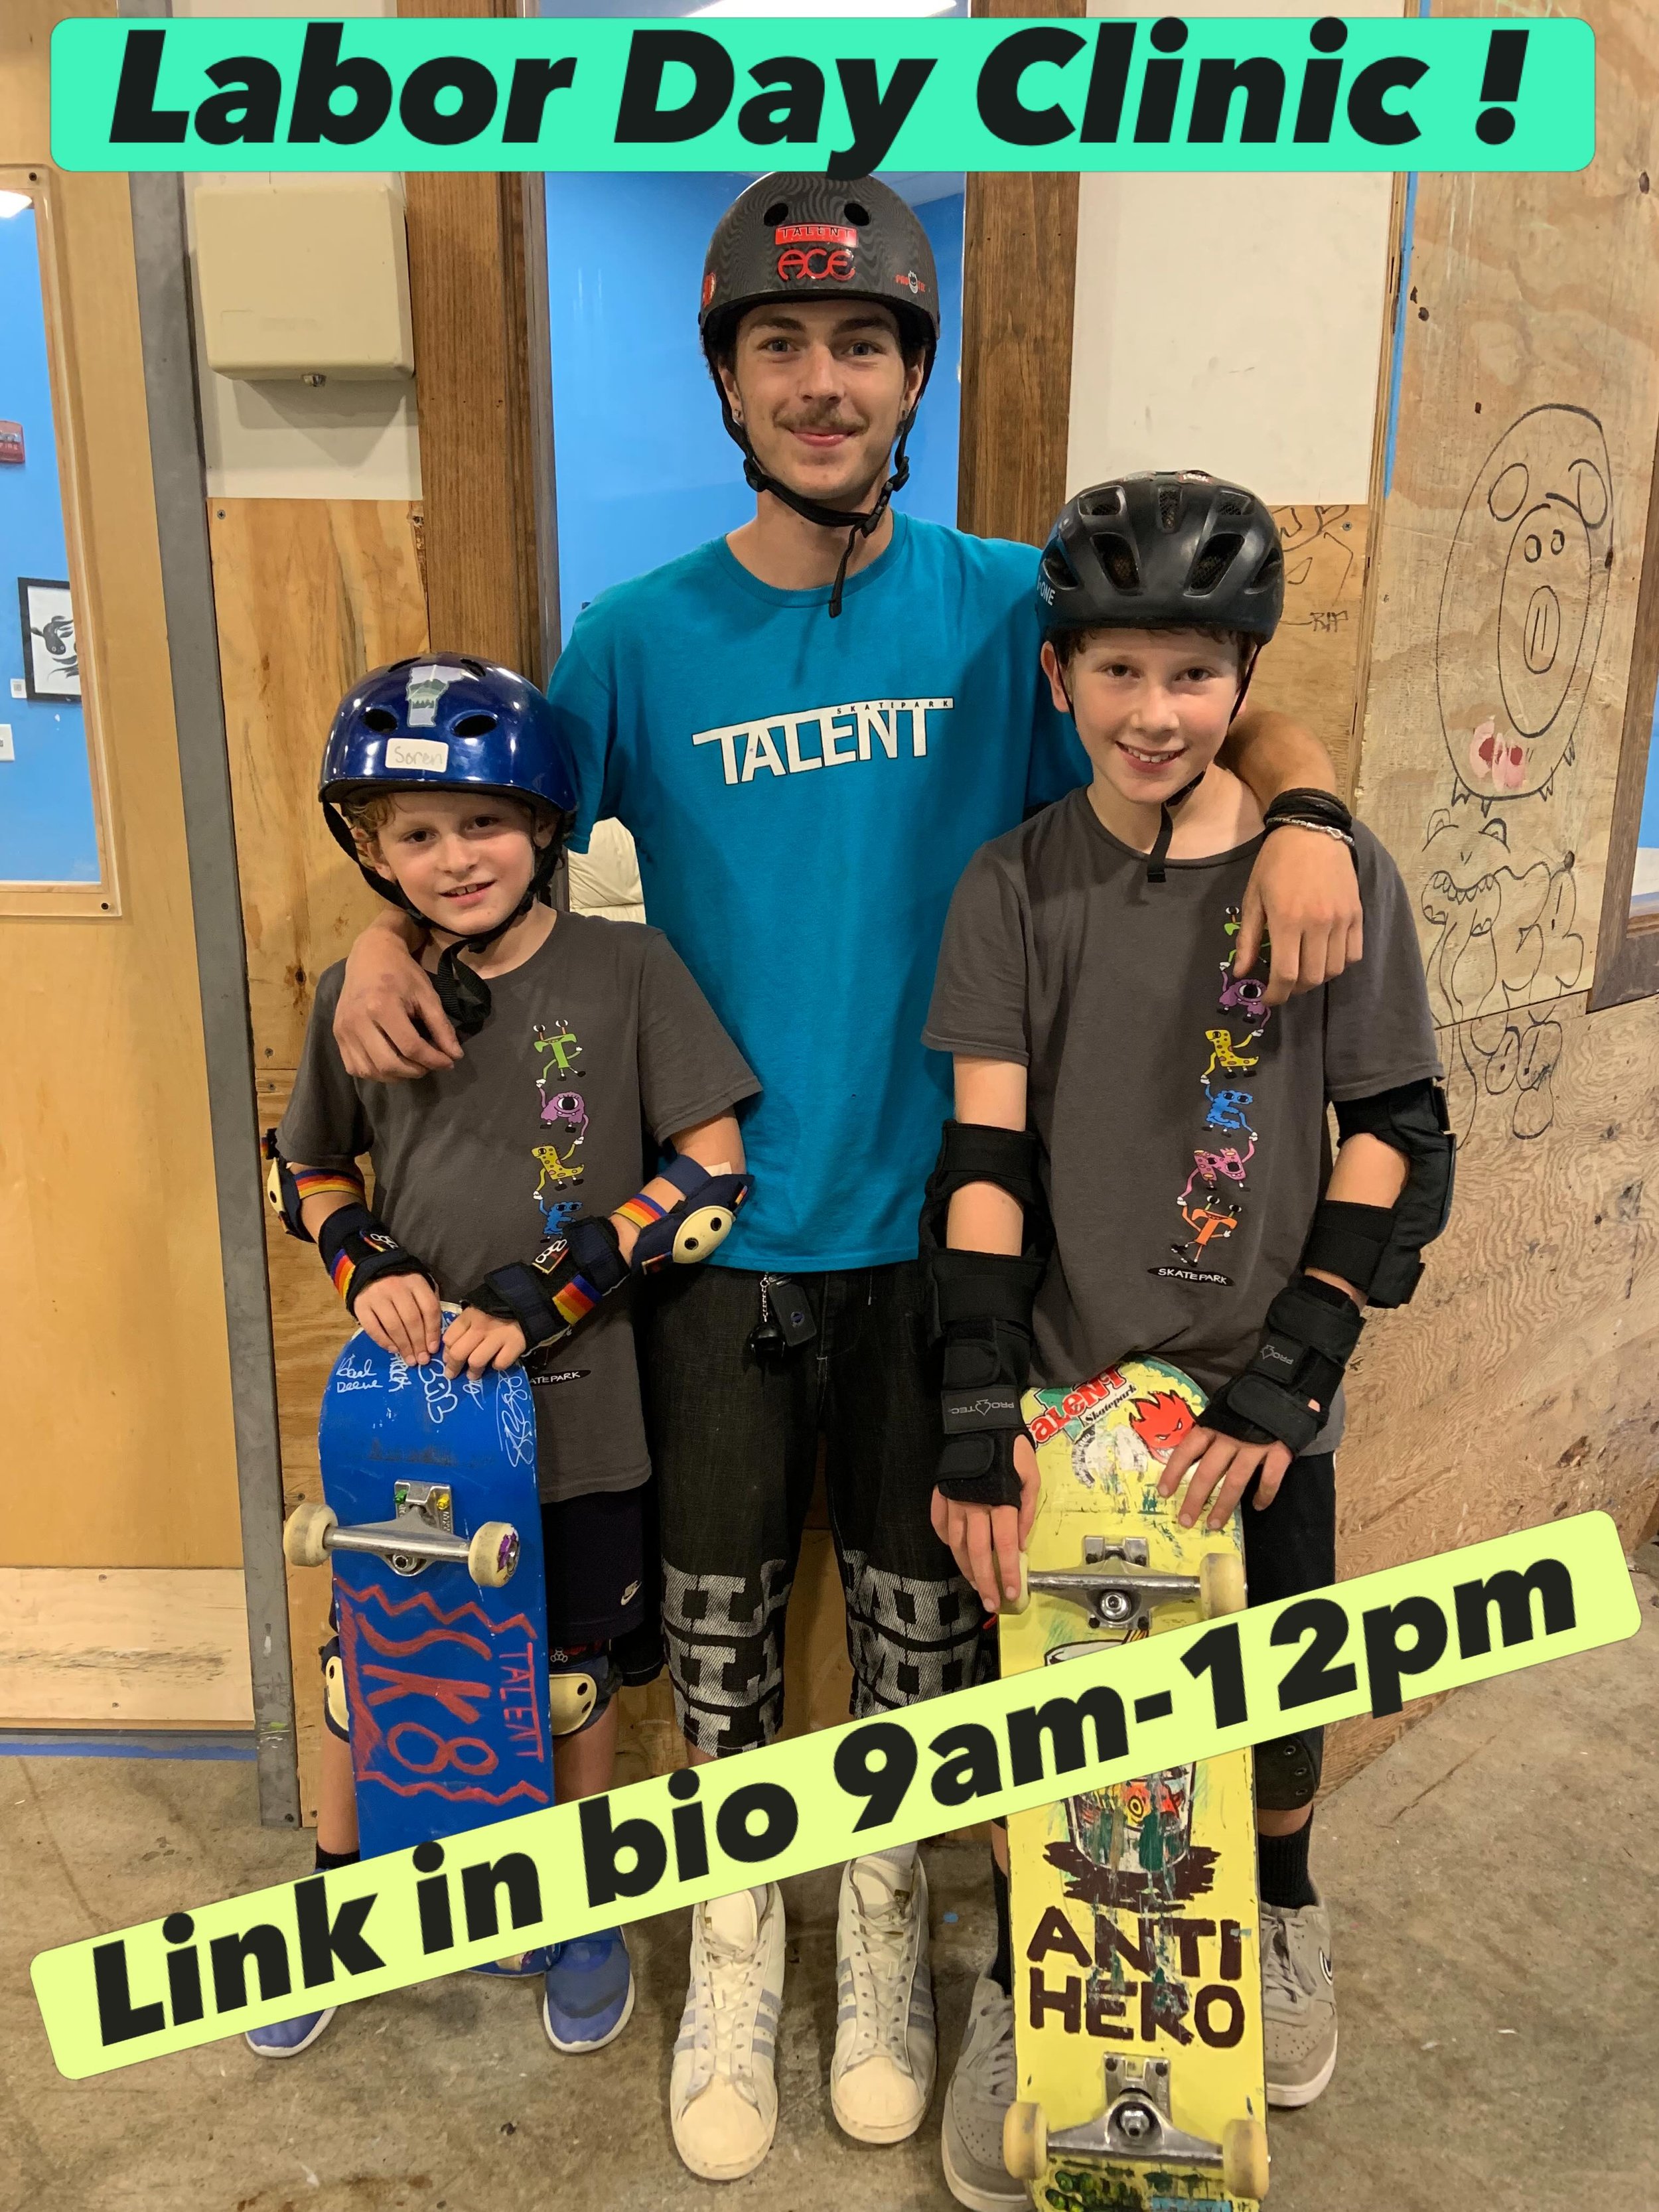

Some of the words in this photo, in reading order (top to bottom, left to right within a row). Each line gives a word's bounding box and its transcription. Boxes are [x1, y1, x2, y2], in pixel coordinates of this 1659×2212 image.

[778, 224, 855, 238] TALENT
[395, 745, 443, 766] Soren
[691, 697, 954, 786] TALENT
[1157, 1268, 1228, 1286] SKATEPARK
[530, 1370, 581, 1384] ATEPARK
[356, 1613, 500, 1776] SK8
[498, 1642, 544, 1763] TALENT
[1027, 1905, 1243, 1981] ANTI
[1028, 1966, 1246, 2049] HERO
